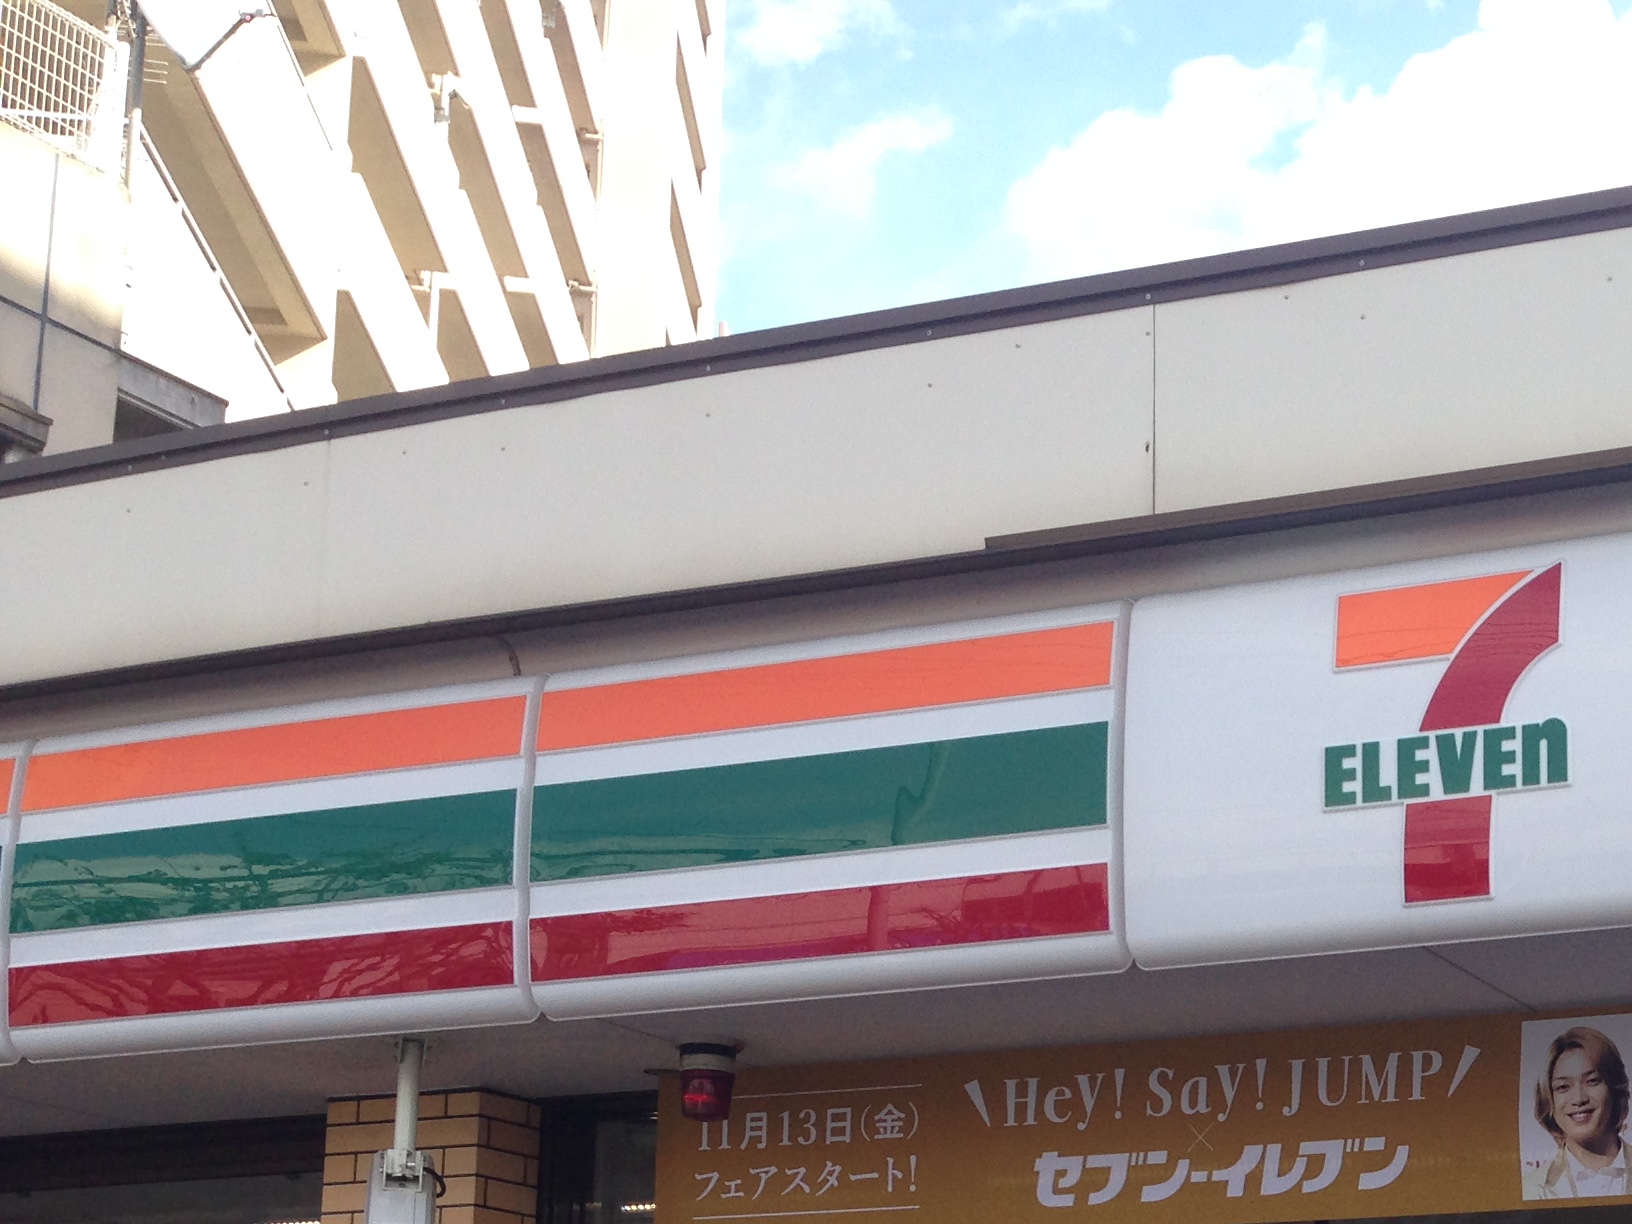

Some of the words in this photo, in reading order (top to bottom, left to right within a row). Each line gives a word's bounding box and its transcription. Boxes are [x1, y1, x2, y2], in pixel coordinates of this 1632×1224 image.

[1334, 560, 1562, 904] 7
[1003, 1068, 1126, 1131] Hey!
[1146, 1058, 1267, 1122] Say!
[1283, 1049, 1444, 1117] JUMP
[695, 1155, 918, 1201] フェアスタート!
